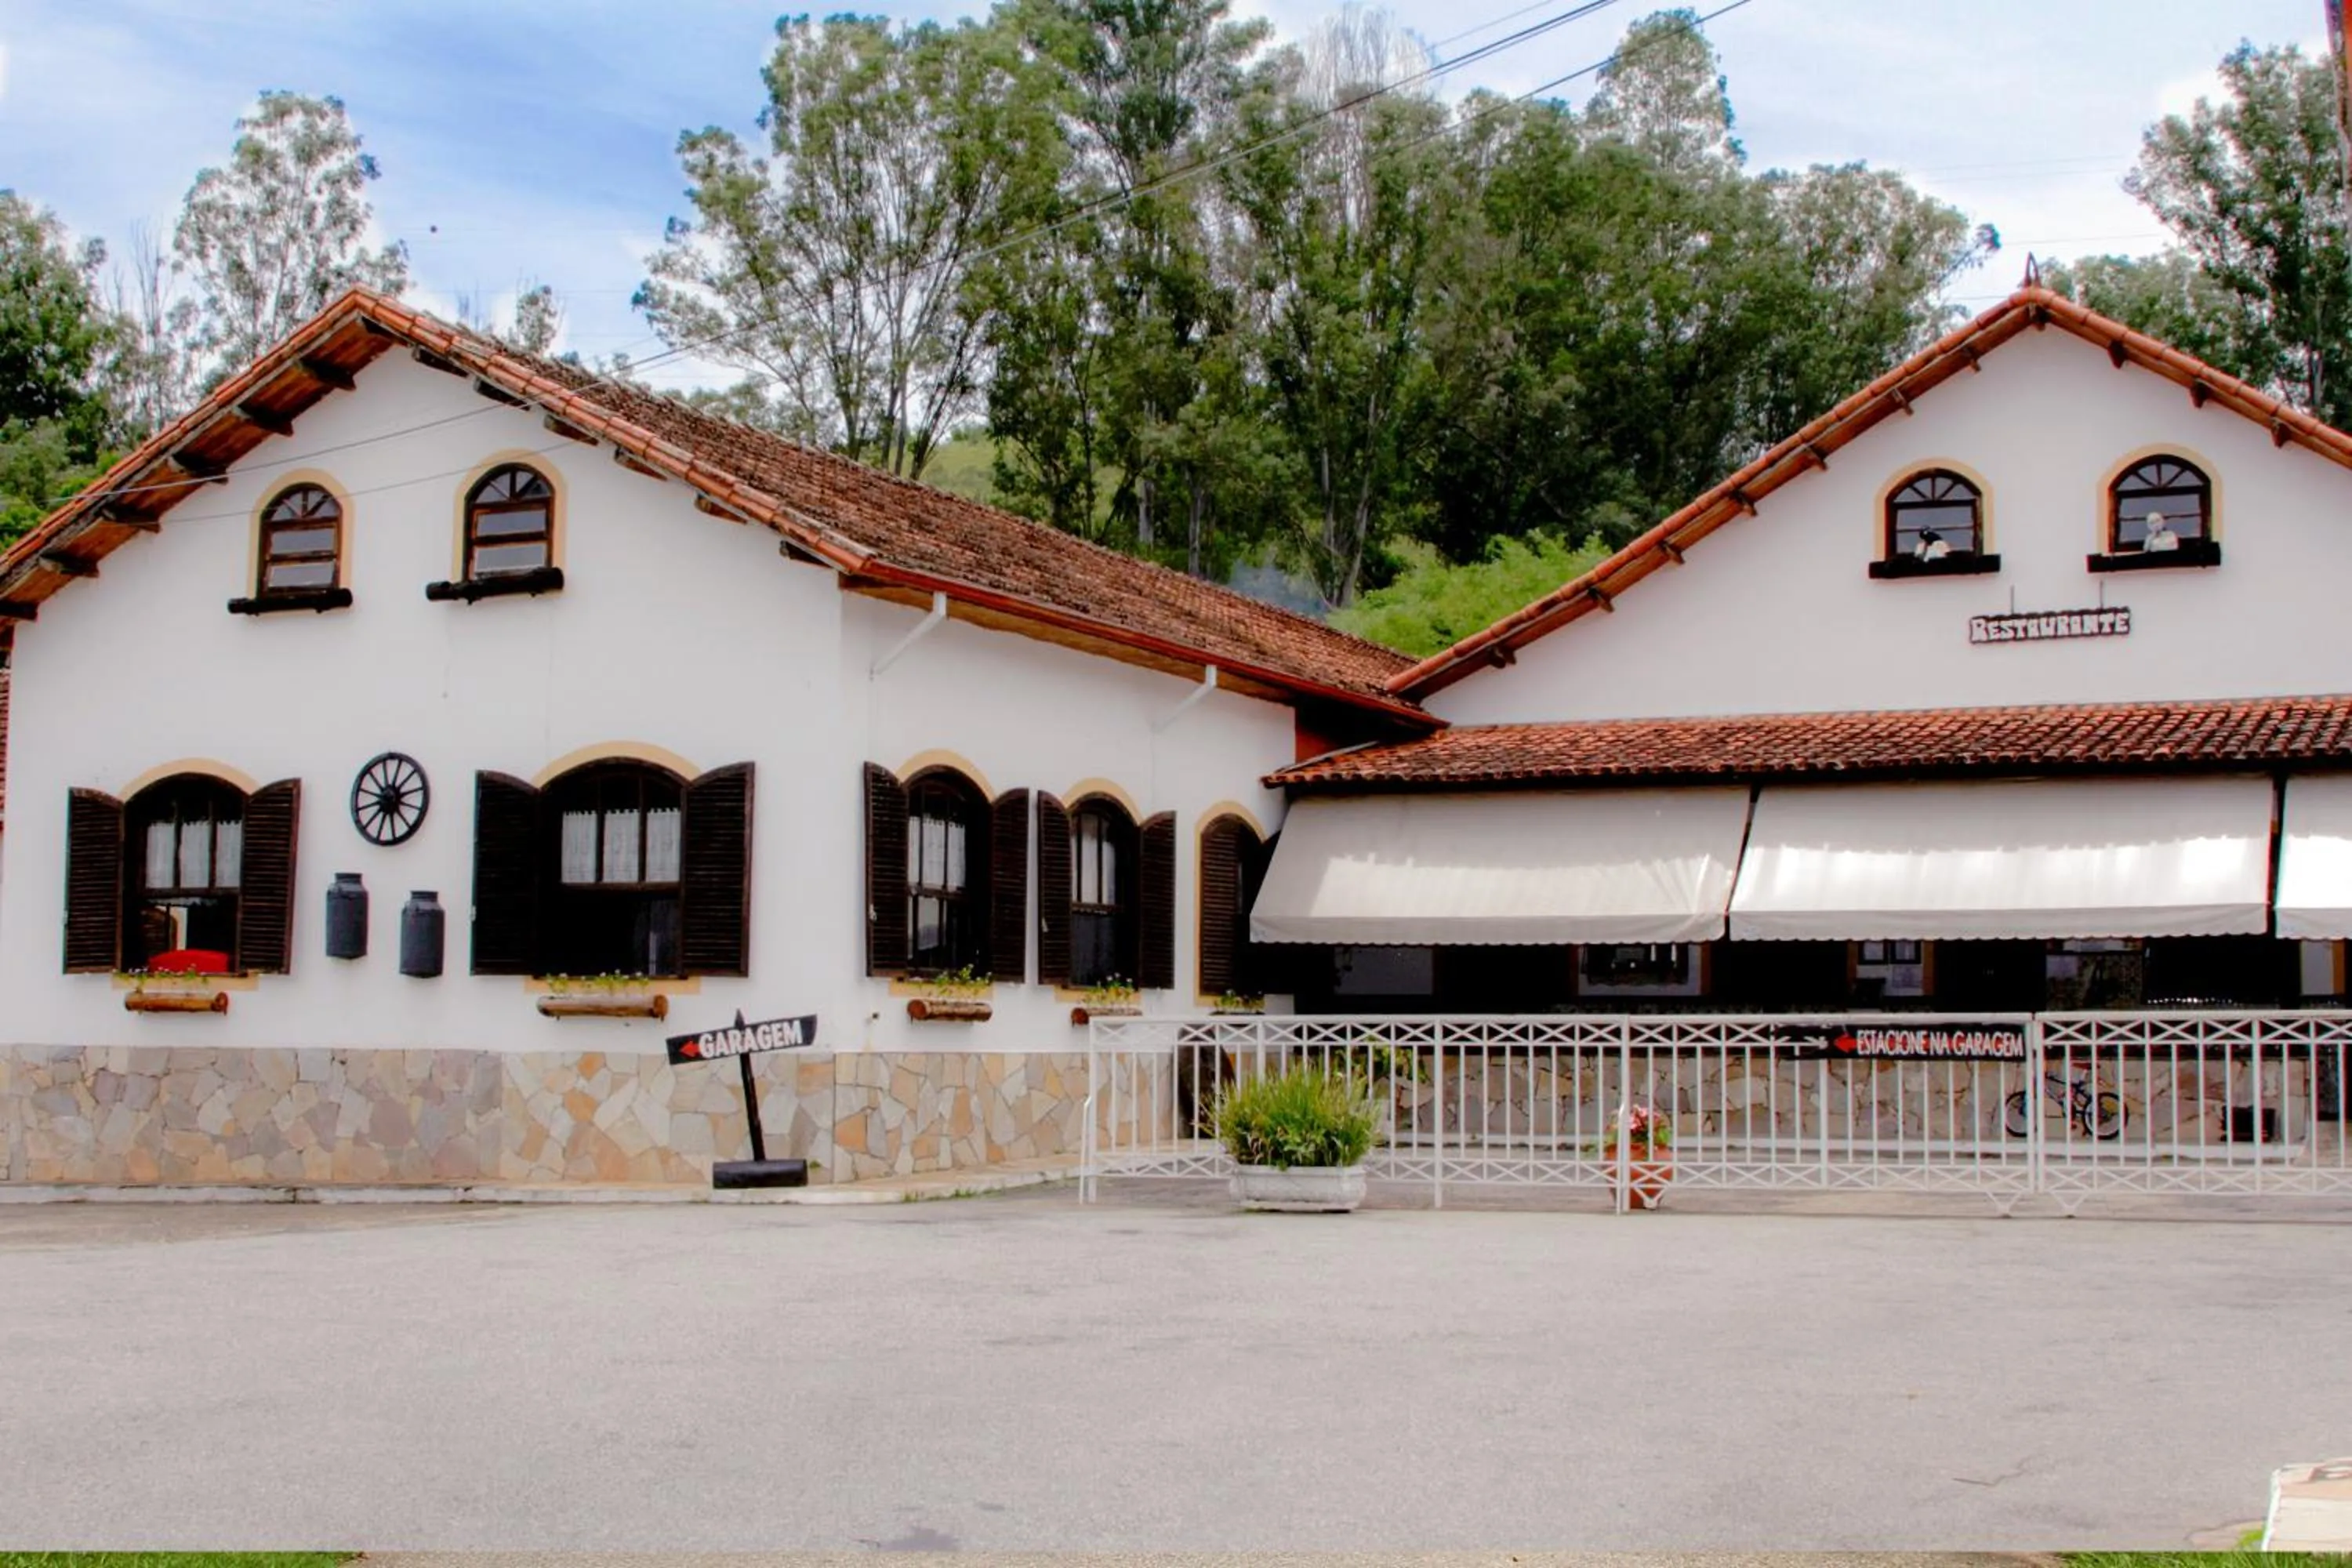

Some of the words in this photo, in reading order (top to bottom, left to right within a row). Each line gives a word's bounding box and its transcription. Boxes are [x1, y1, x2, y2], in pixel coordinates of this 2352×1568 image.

[1970, 611, 2130, 643] RESTAURANTE
[699, 1019, 803, 1058] GARAGEM
[1856, 1029, 1928, 1056] ESTACIONE
[1929, 1030, 1950, 1056] NA
[1951, 1030, 2024, 1057] GARAGEM
